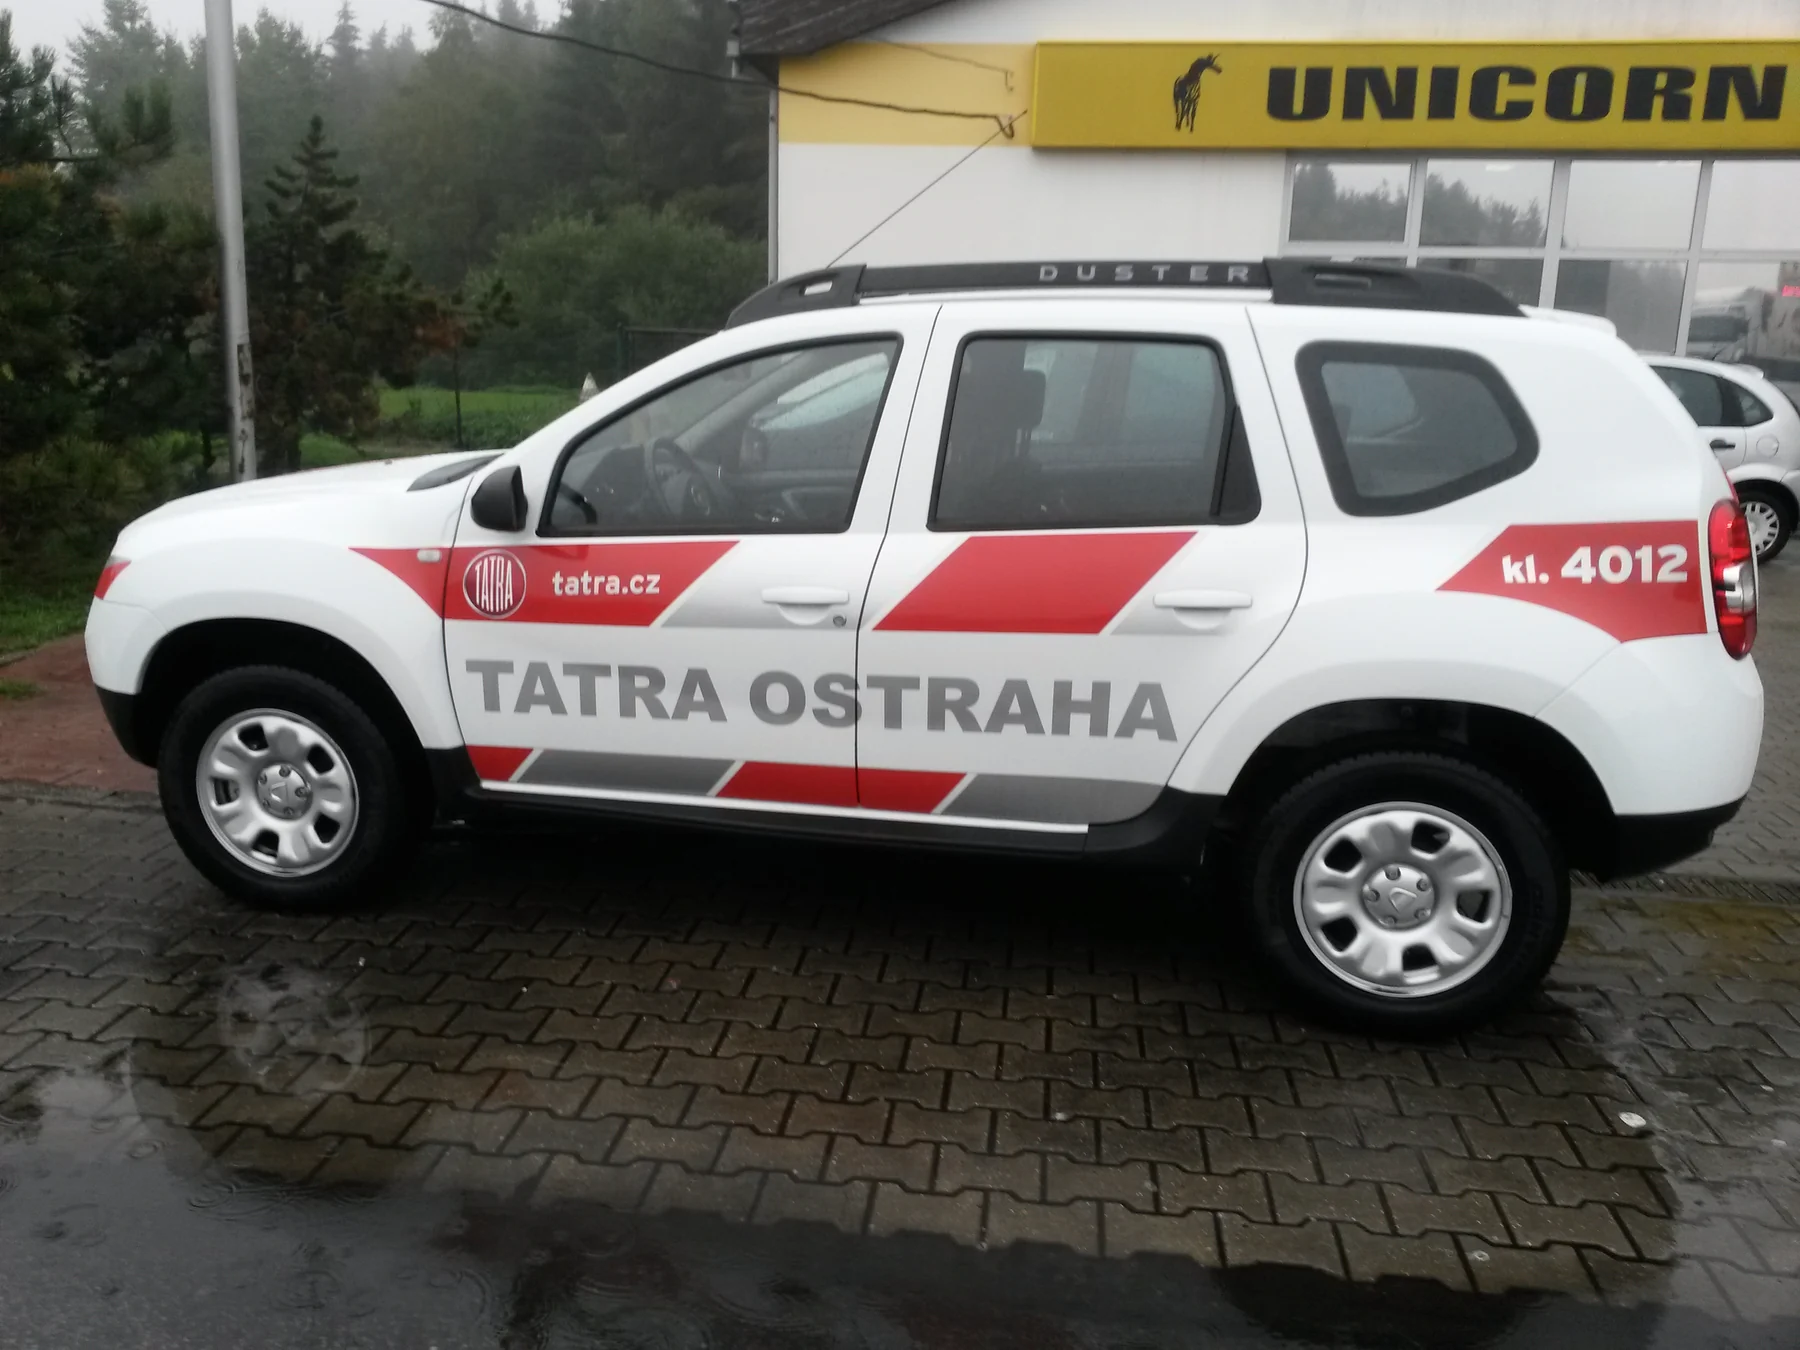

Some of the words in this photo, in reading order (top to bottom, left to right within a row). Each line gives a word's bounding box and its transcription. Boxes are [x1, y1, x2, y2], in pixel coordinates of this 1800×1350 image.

[1267, 65, 1787, 122] UNICORN
[1039, 264, 1249, 282] DUSTER
[475, 556, 513, 613] TATRA
[552, 570, 660, 596] tatra.cz
[1502, 554, 1549, 584] kl.
[1561, 544, 1688, 584] 4012
[466, 659, 727, 722] TATRA
[749, 671, 1178, 742] OSTRAHA
